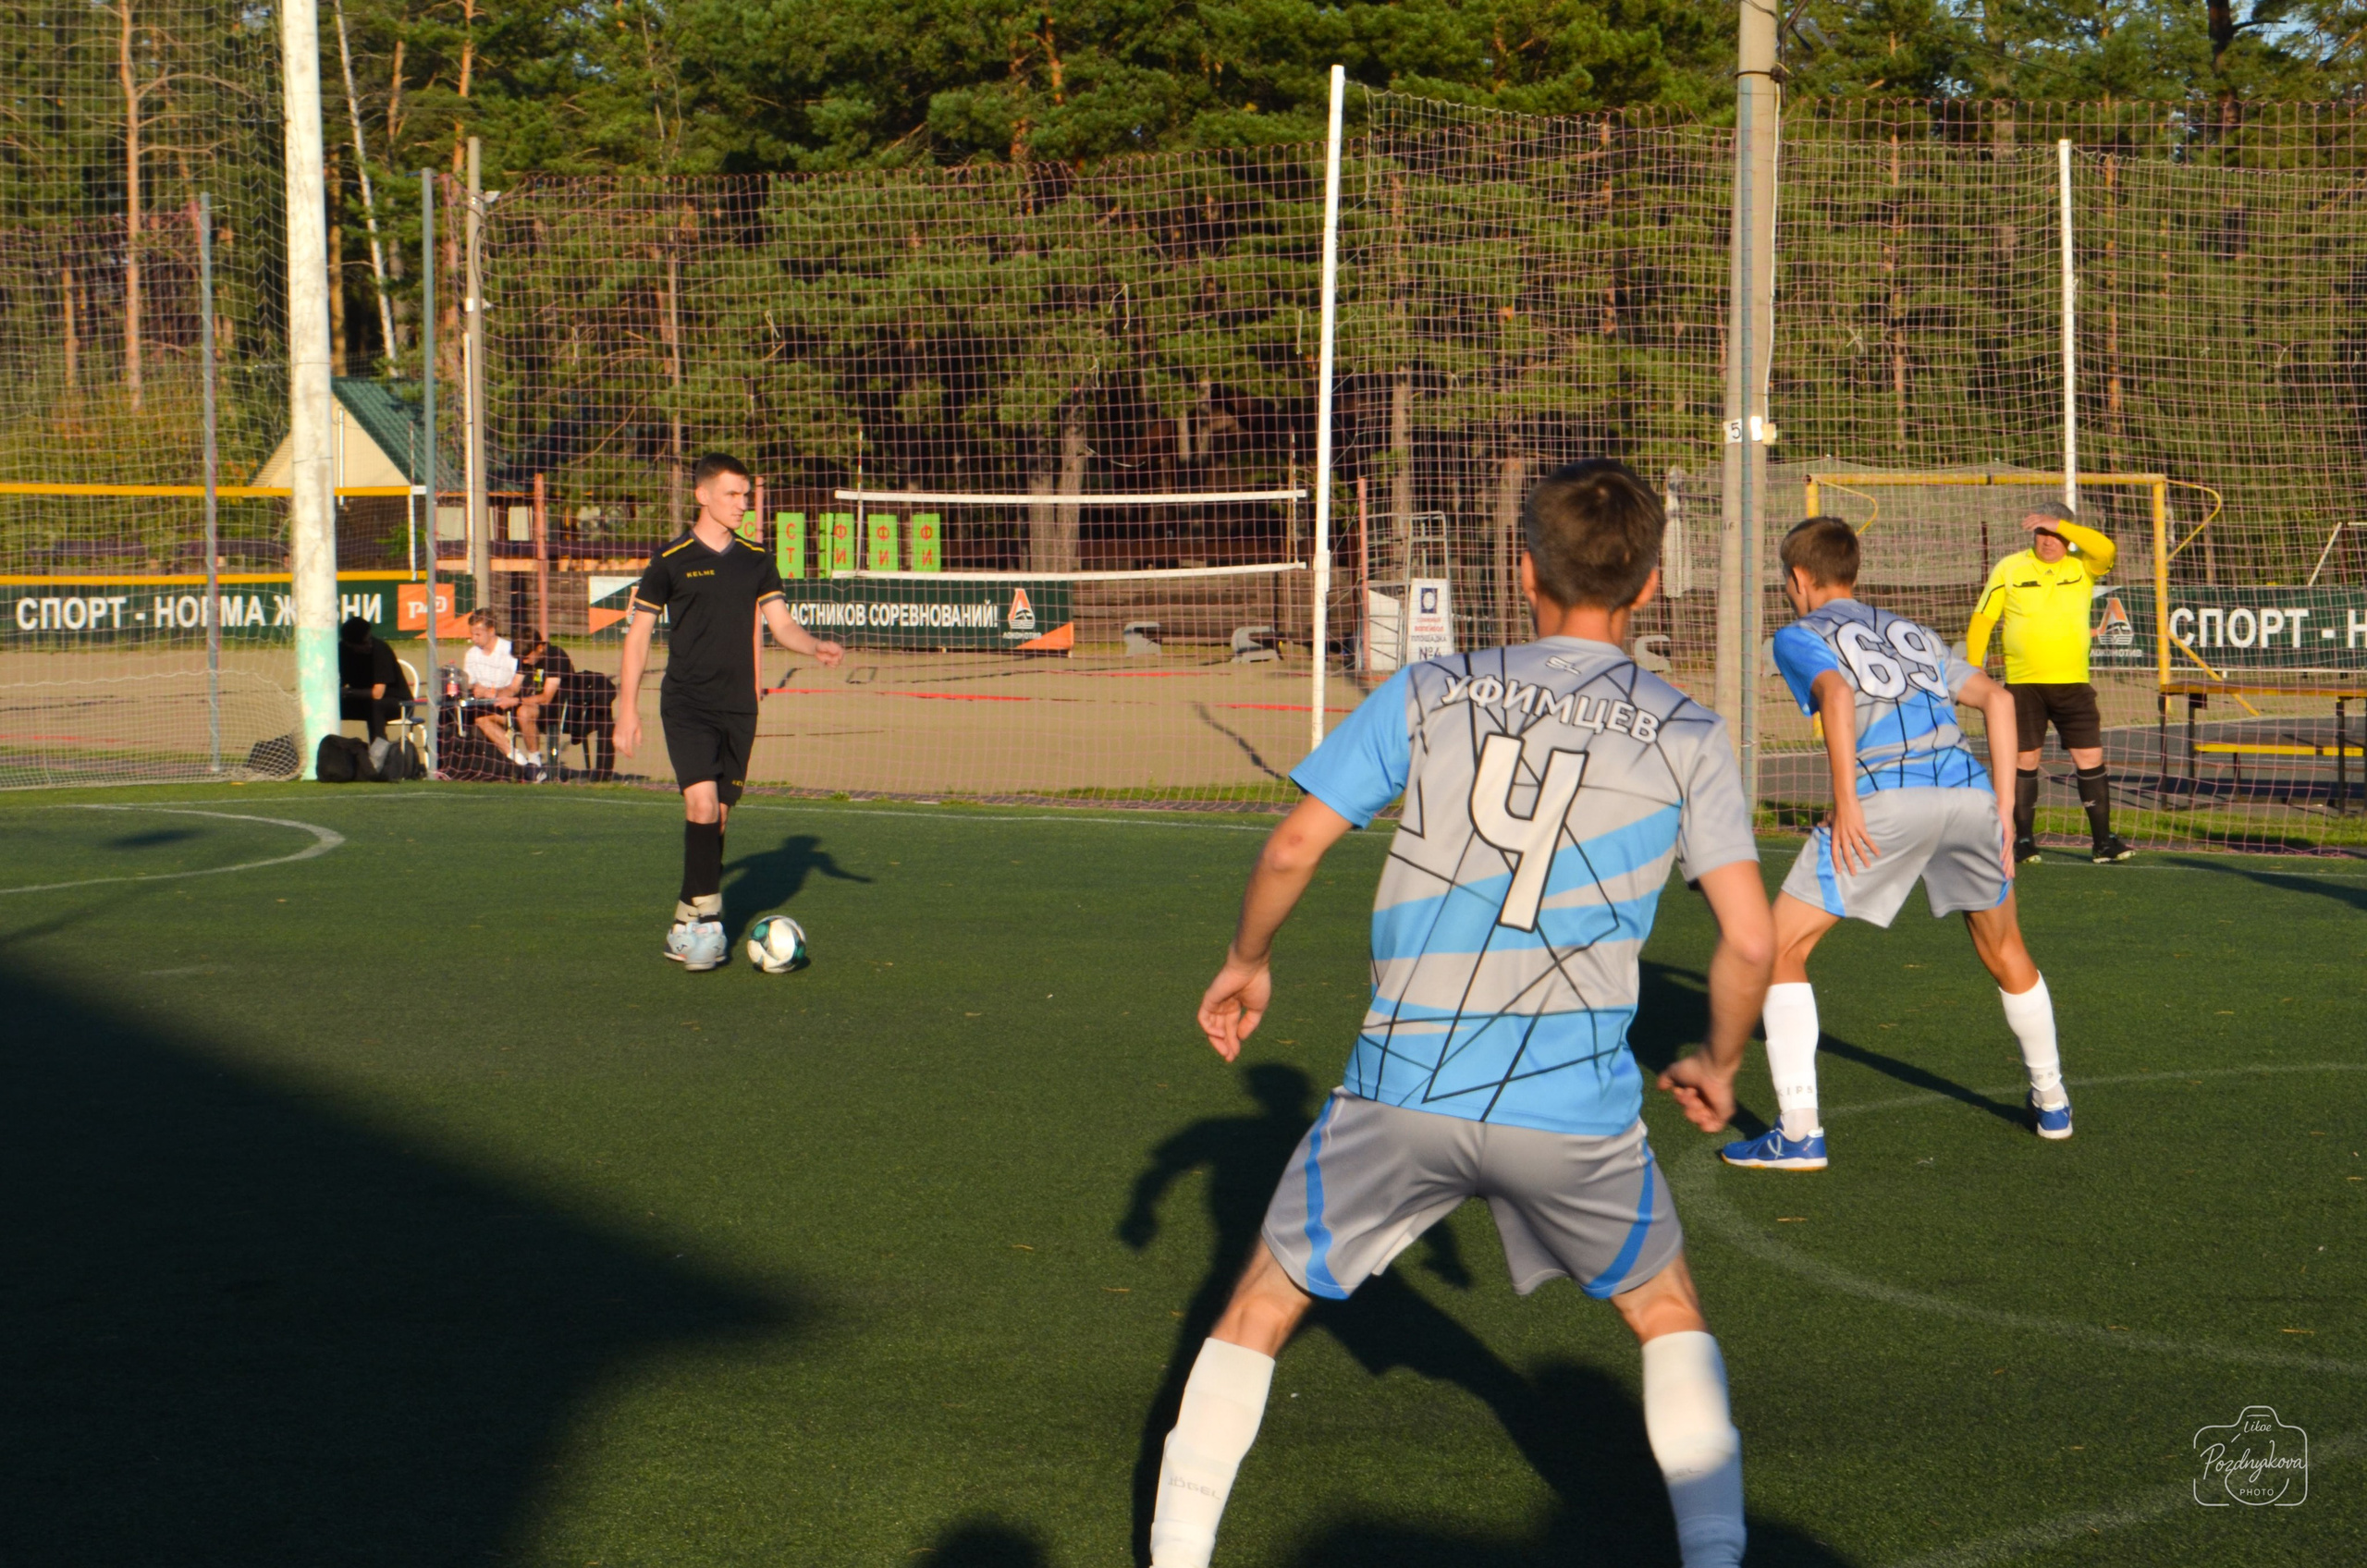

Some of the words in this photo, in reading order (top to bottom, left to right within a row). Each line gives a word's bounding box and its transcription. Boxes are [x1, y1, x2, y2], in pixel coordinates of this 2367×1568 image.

[1731, 422, 1741, 439] 5
[686, 569, 716, 579] KELME
[17, 596, 127, 631] СПОРТ
[274, 594, 382, 626] ЖНИ
[786, 602, 865, 627] АСТНИКОВ
[869, 599, 999, 628] СОРЕВНОВАНИЙ!
[2169, 607, 2309, 648] СПОРТ
[1835, 619, 1947, 699] 69
[1441, 674, 1661, 744] УФИМЦЕВ
[1468, 731, 1589, 933] 4
